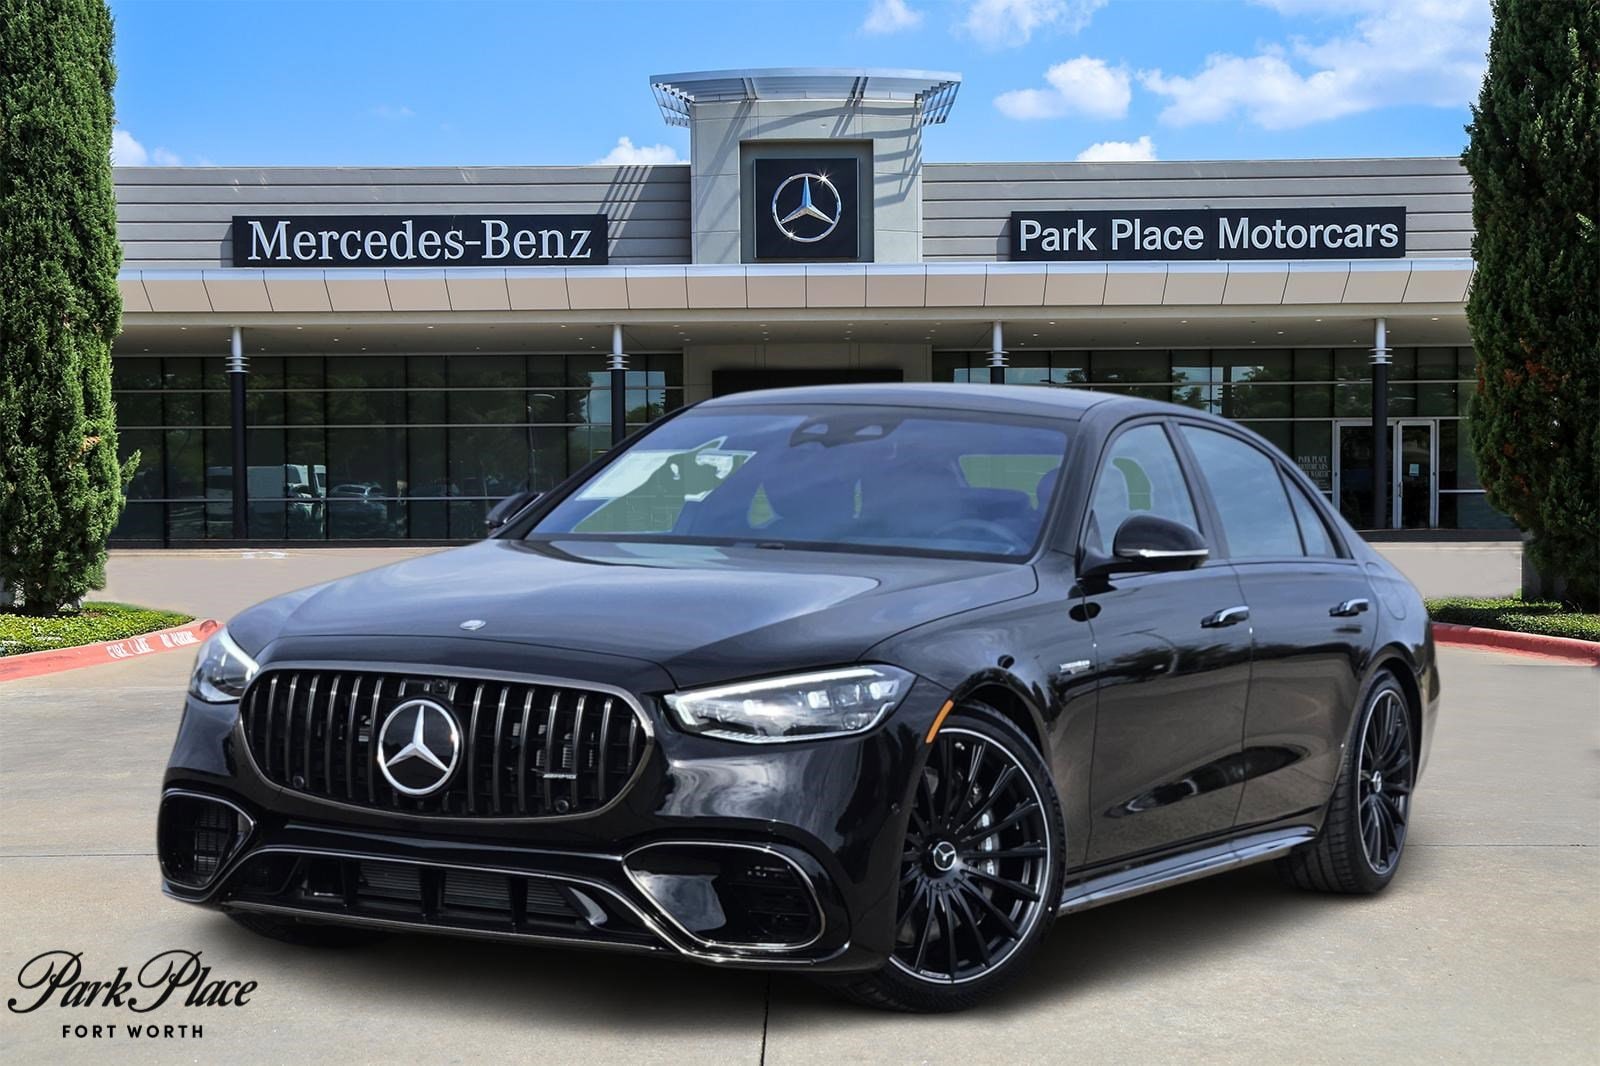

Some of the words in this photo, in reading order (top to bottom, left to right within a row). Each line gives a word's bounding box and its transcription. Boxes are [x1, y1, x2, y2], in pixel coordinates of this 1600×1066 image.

[247, 219, 592, 261] Mercedes-Benz
[1019, 219, 1098, 252] Park
[1111, 218, 1205, 251] Place
[1218, 216, 1399, 250] Motorcars
